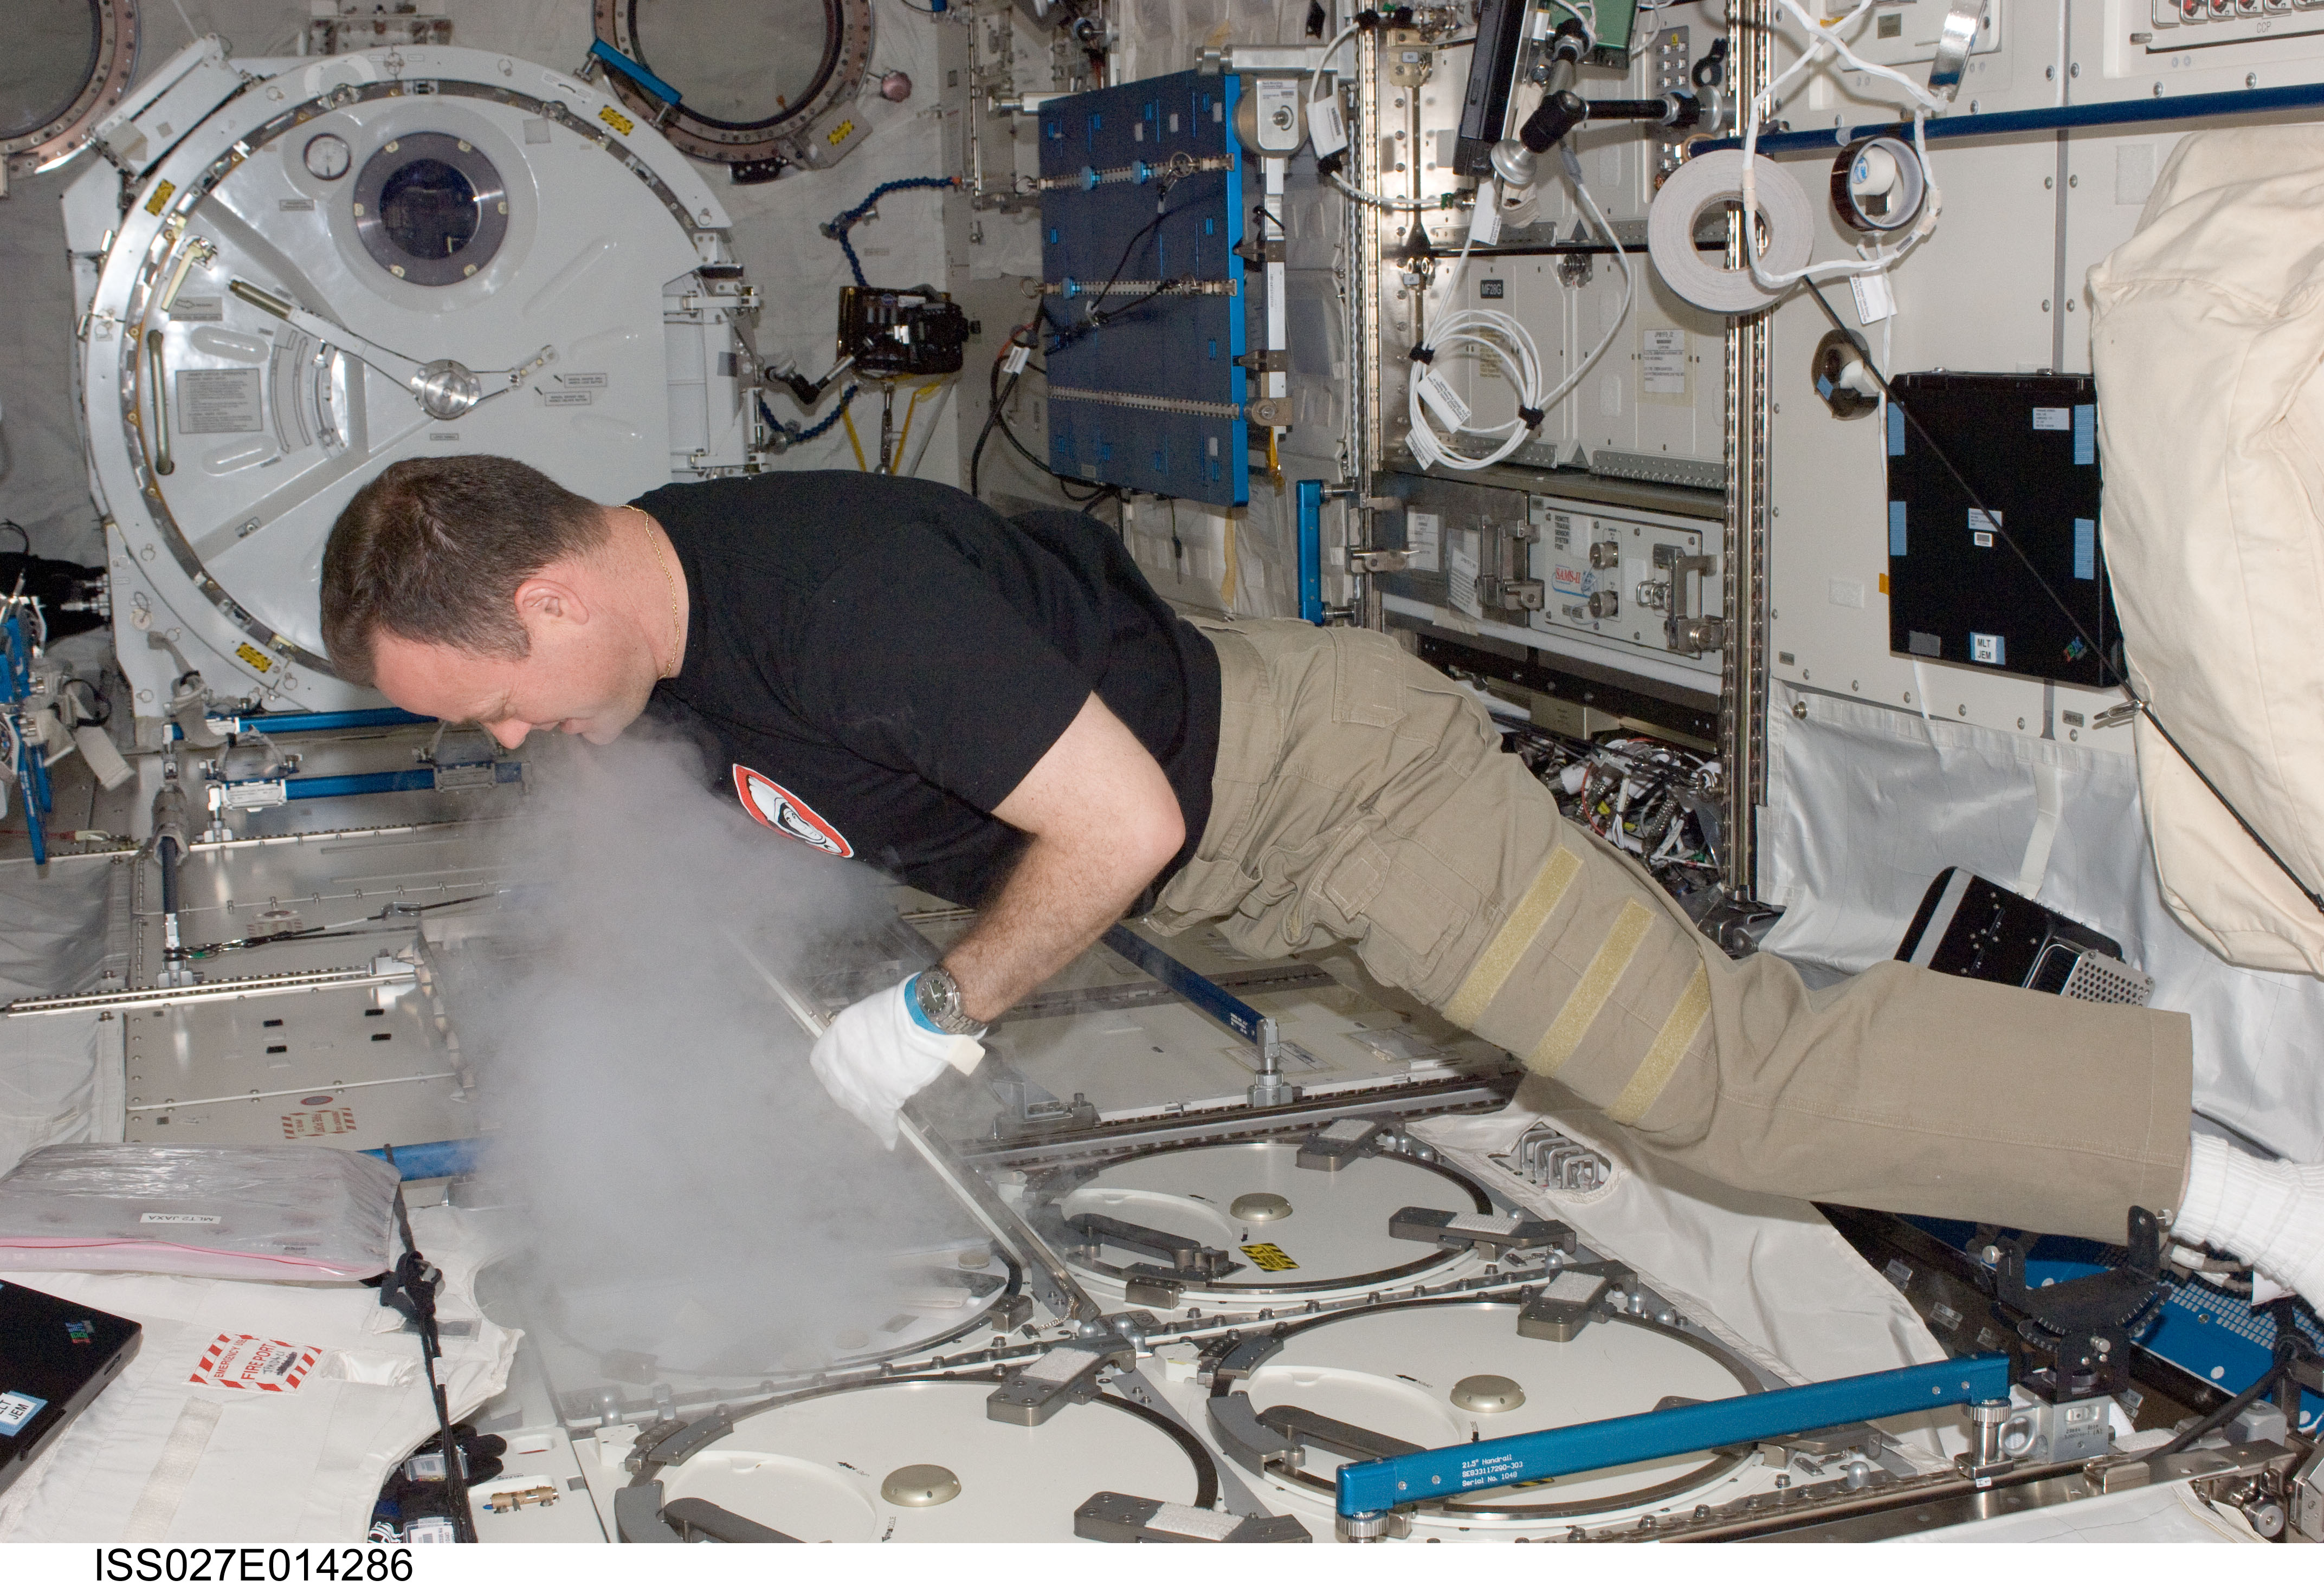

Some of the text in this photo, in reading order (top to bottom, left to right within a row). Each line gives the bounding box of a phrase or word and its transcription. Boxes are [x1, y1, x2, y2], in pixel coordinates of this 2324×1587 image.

[2256, 21, 2271, 33] CCP
[1481, 283, 1501, 295] MF28G
[1555, 515, 1570, 523] REMOTE
[1555, 568, 1581, 584] SAMS-II
[1977, 638, 1991, 647] MLT
[1977, 650, 1991, 659] JEM
[214, 1339, 248, 1378] EMERGENCY USE
[241, 1343, 277, 1381] FIRE PORT
[9, 1403, 29, 1420] JEM
[1462, 1454, 1512, 1468] 21.5" Handrail
[1462, 1477, 1484, 1487] Serial
